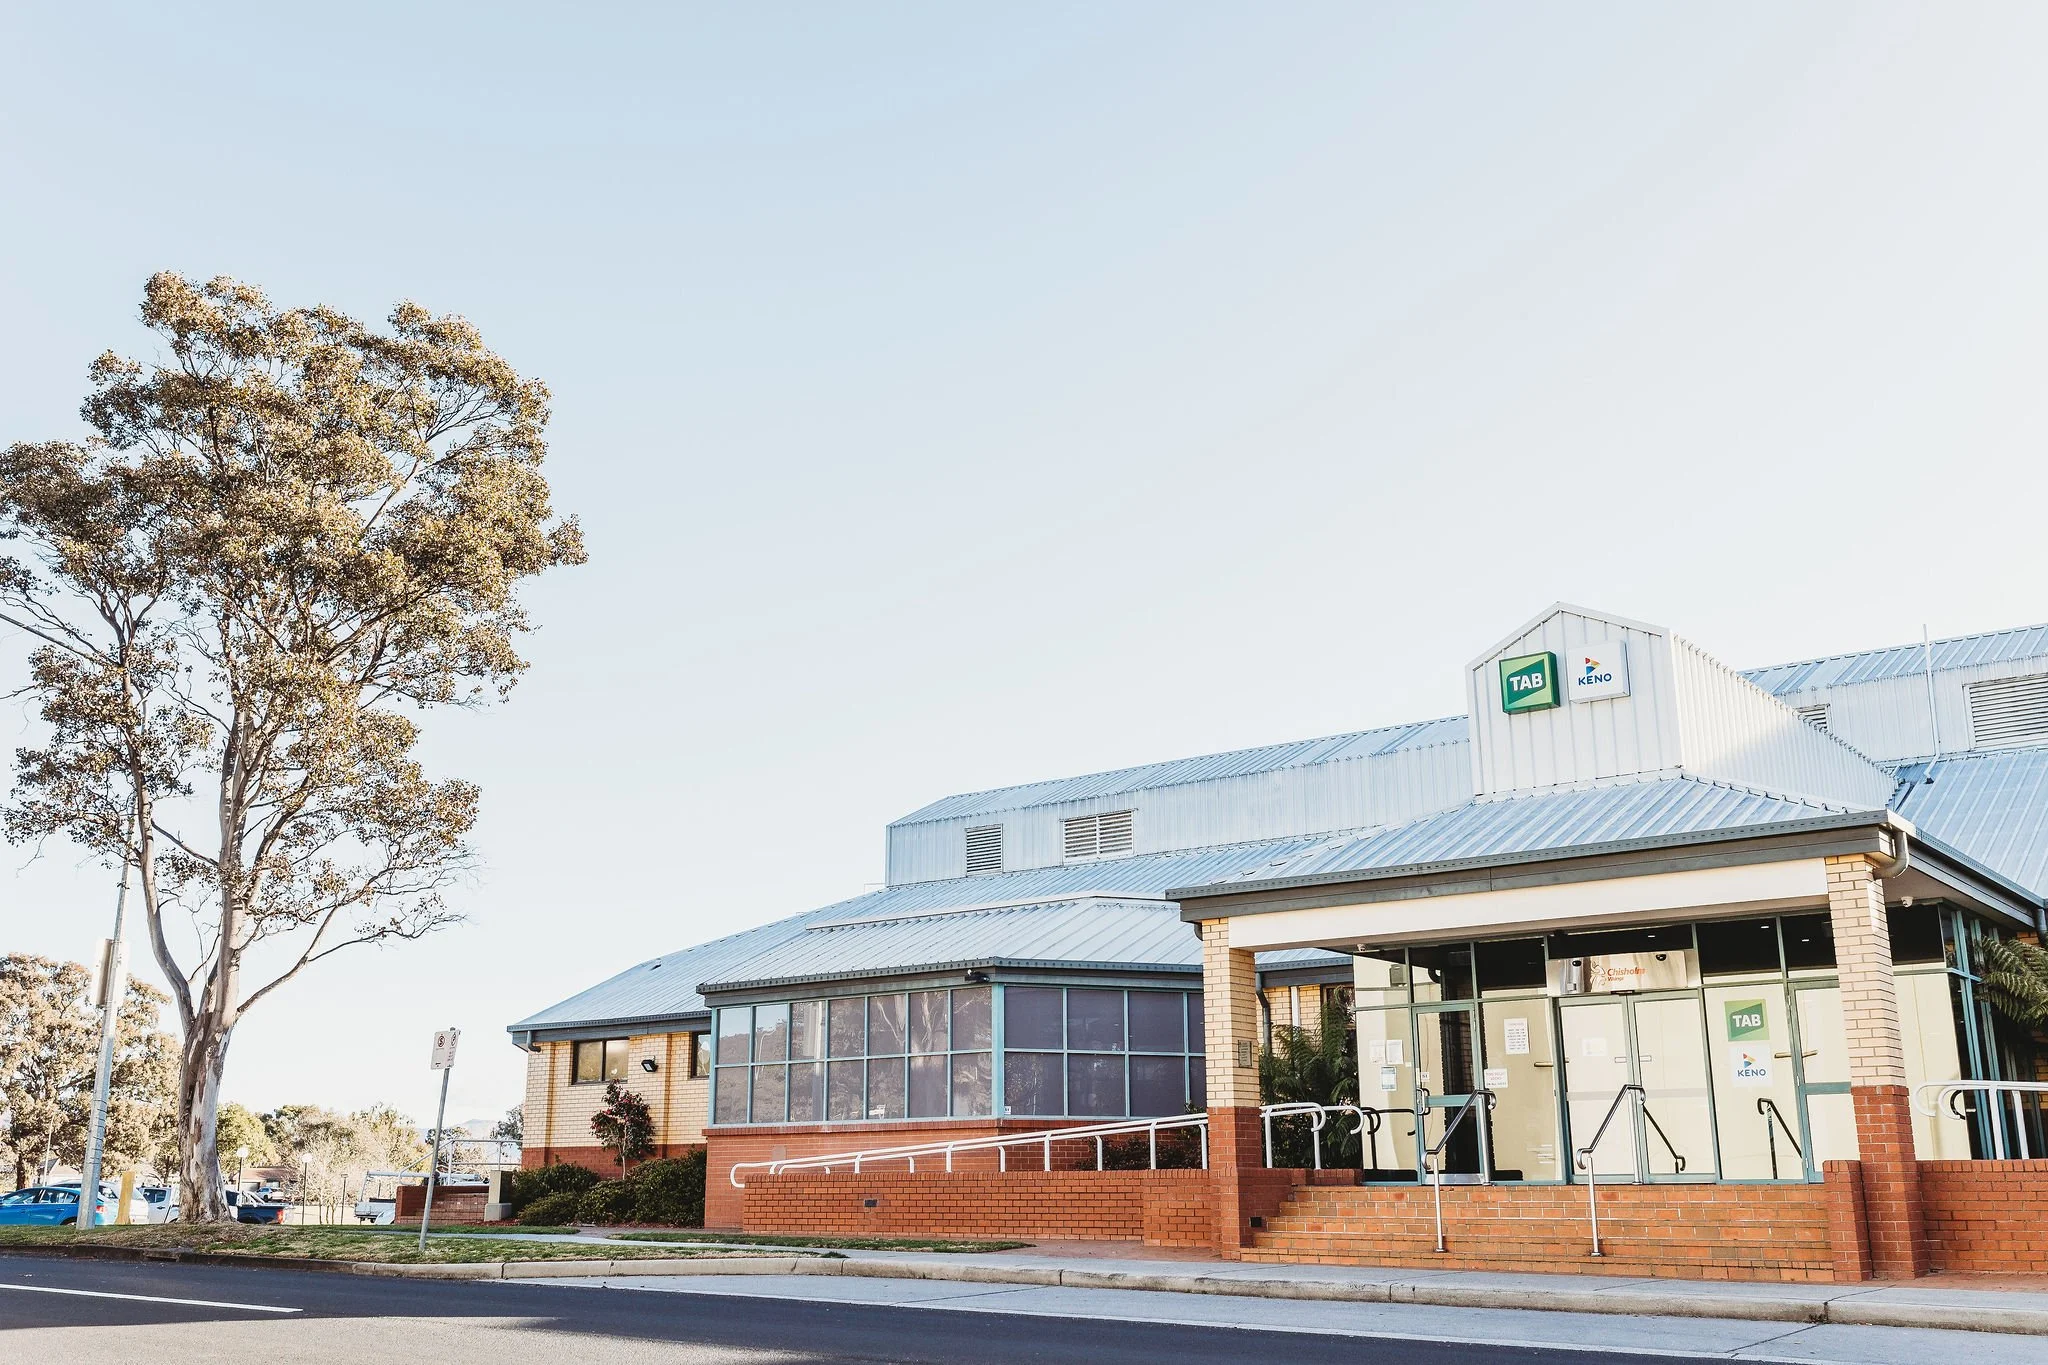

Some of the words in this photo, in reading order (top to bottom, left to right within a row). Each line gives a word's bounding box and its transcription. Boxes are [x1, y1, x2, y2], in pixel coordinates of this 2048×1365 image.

[1509, 673, 1543, 691] TAB
[1578, 673, 1612, 686] KENO
[1732, 1014, 1761, 1028] TAB
[1737, 1069, 1767, 1077] KENO
